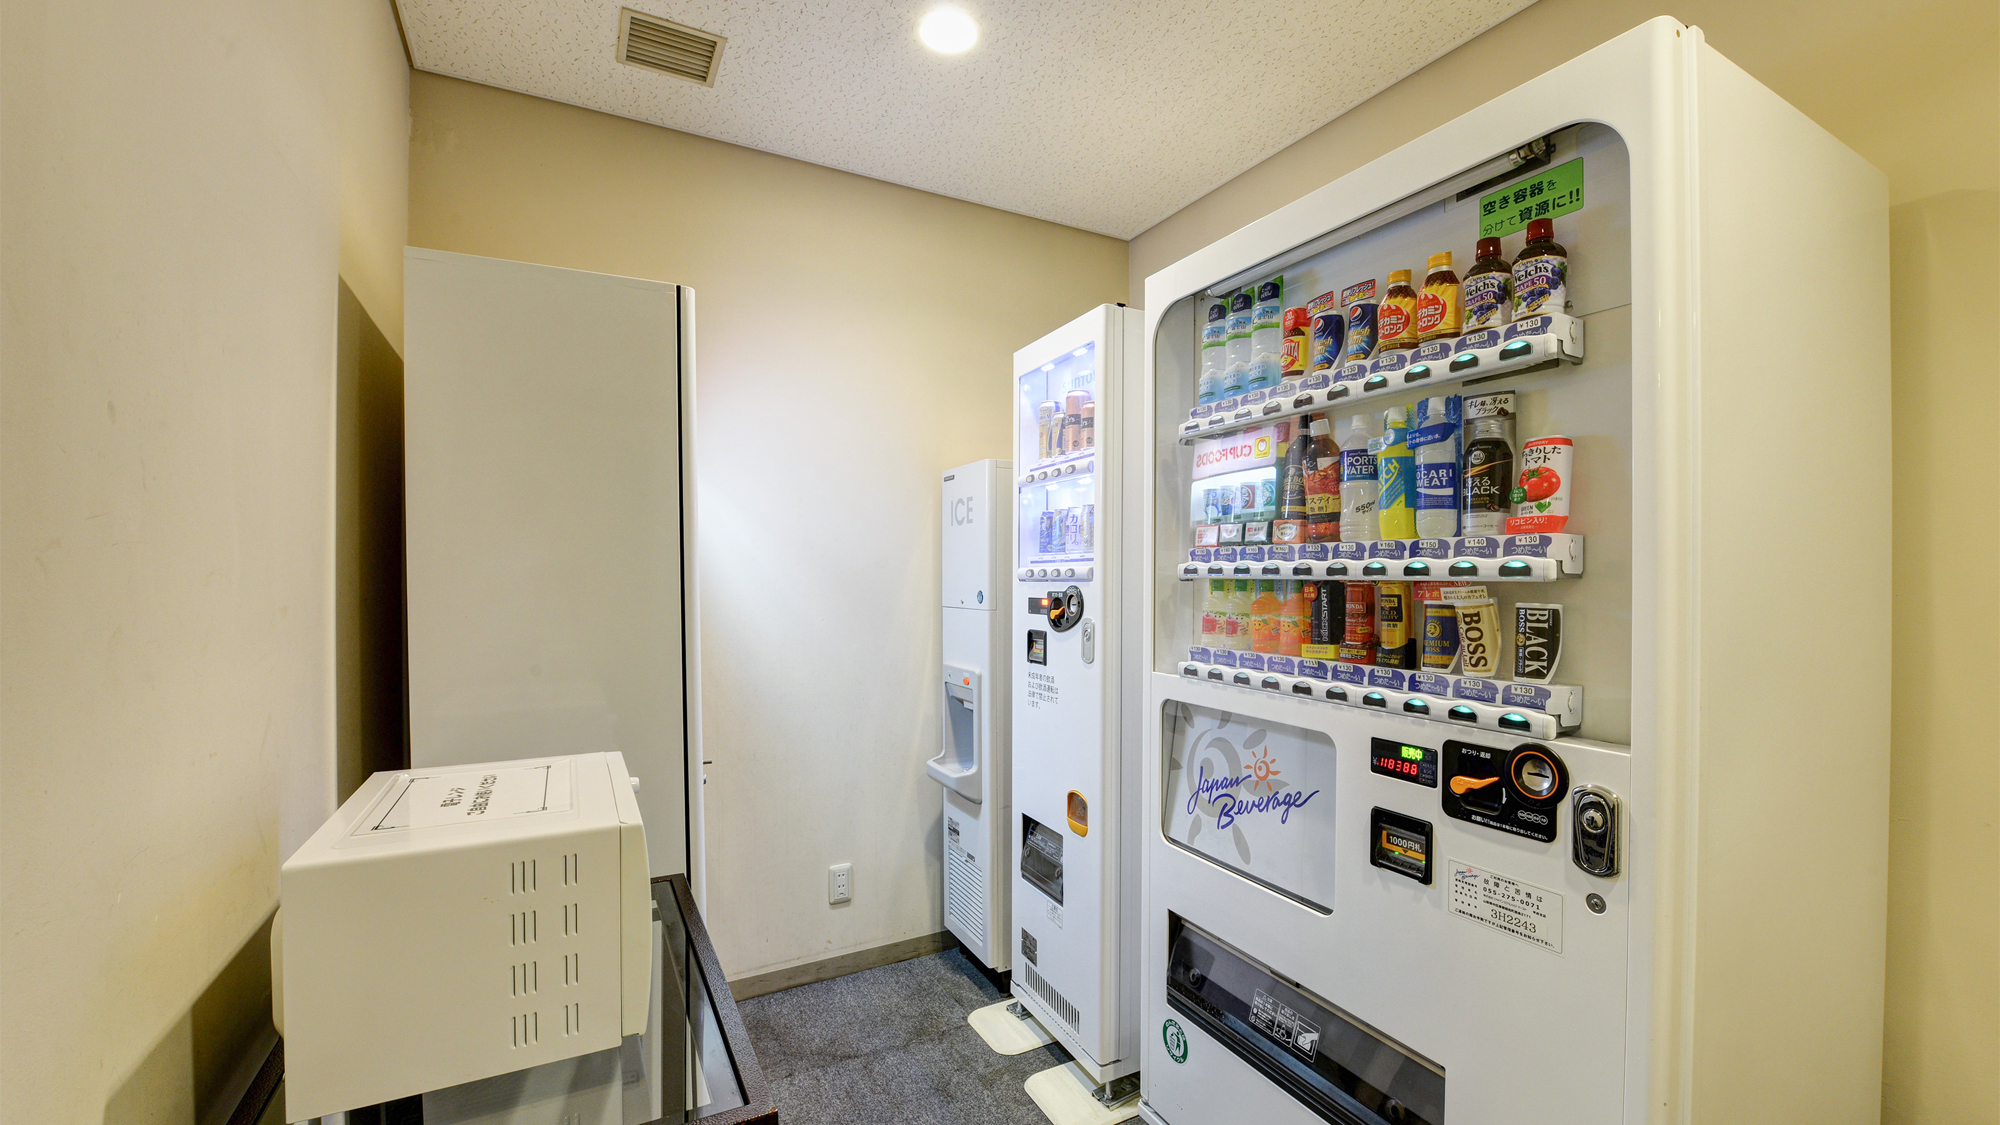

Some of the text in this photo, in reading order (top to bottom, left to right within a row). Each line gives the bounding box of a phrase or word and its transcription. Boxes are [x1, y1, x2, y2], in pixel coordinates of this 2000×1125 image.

[1482, 179, 1557, 216] 空き容器を
[1533, 276, 1547, 287] 50
[1482, 291, 1494, 302] 50
[1519, 318, 1539, 329] ¥130
[1468, 333, 1486, 342] ¥130
[1422, 346, 1438, 354] ¥130
[1343, 367, 1356, 375] ¥130
[1476, 406, 1499, 415] ブラック
[1524, 454, 1551, 467] トマト
[951, 496, 974, 526] ICE
[1467, 538, 1485, 546] ¥140
[1462, 611, 1488, 669] BOSS
[1525, 609, 1549, 675] BLACK
[1417, 674, 1433, 682] ¥130
[1463, 680, 1480, 688] ¥130
[1513, 686, 1533, 694] ¥130
[1402, 746, 1423, 761] 販売中
[439, 787, 466, 808] 電子レンジ
[1187, 766, 1320, 830] Japan Beverage
[1389, 835, 1422, 853] 1000円札
[1482, 887, 1541, 910] 055-275-0071
[1490, 909, 1537, 934] 3H2243
